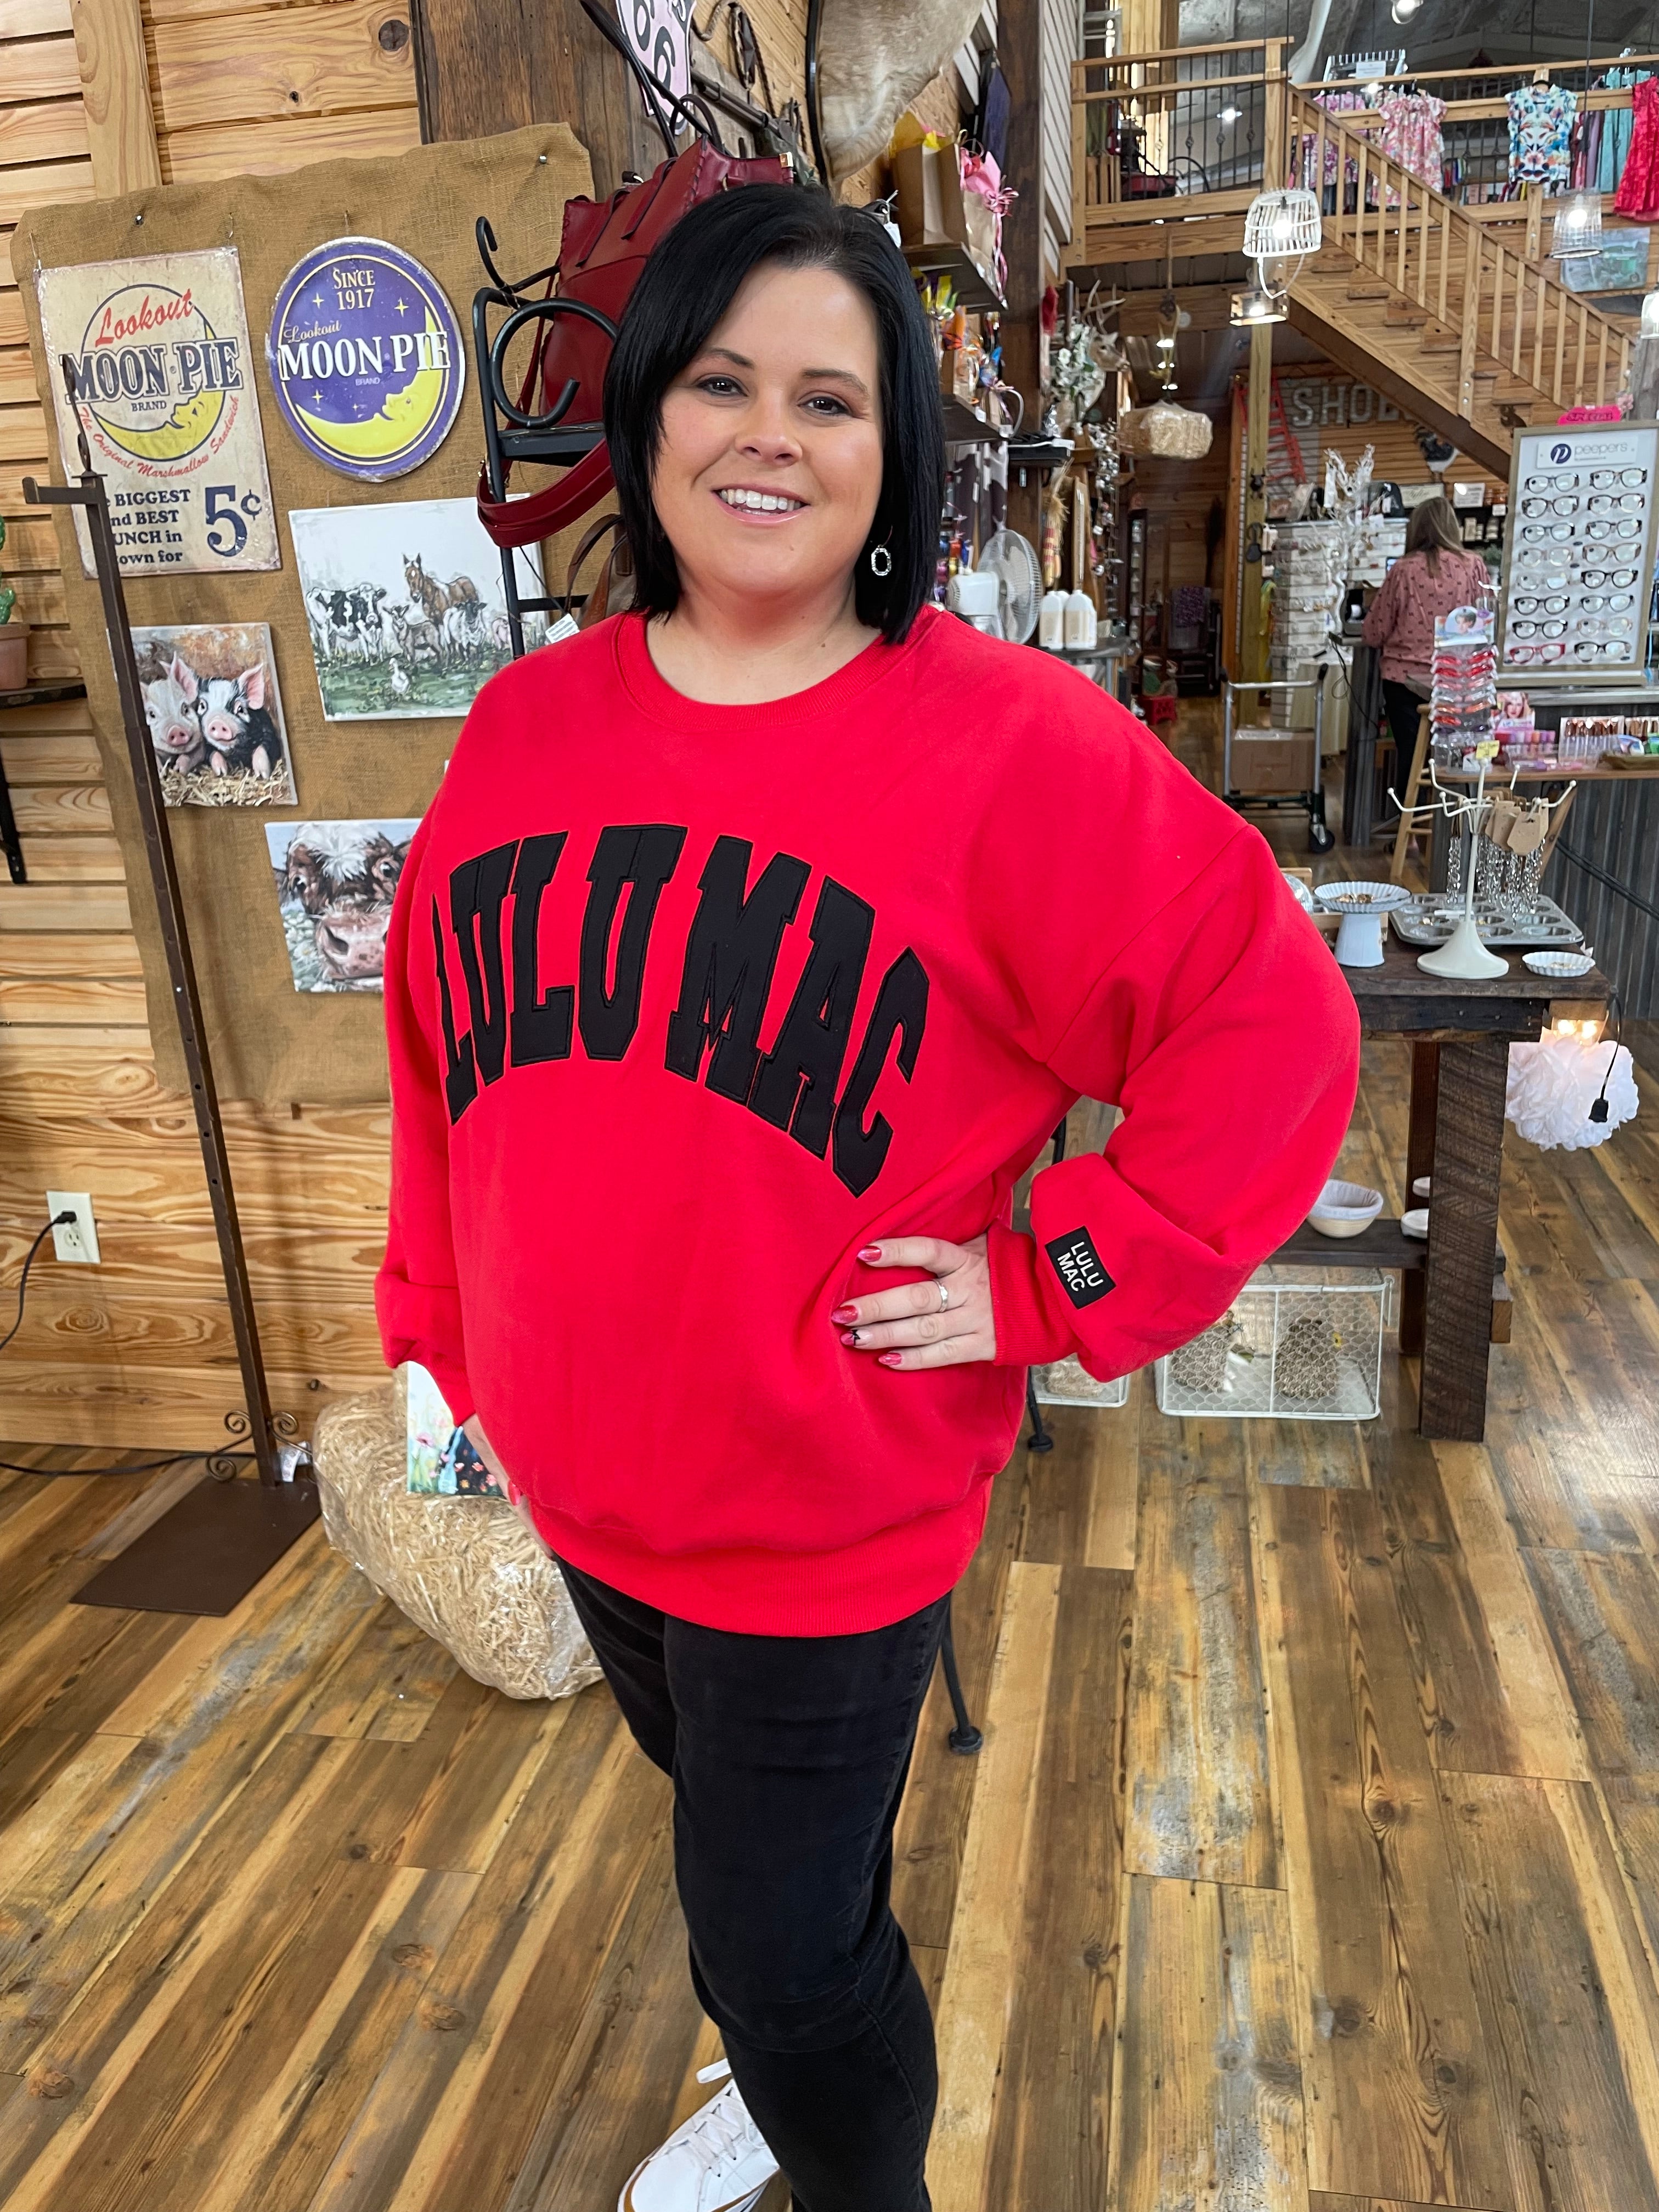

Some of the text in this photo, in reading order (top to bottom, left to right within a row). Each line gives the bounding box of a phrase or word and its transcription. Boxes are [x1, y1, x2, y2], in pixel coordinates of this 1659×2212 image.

[332, 268, 376, 289] SINCE
[336, 289, 375, 311] 1917
[95, 289, 195, 348] Lookout
[283, 320, 342, 344] Lookout
[278, 331, 451, 382] MOON PIE
[60, 337, 244, 403] MOON PIE
[355, 377, 381, 386] BRAND
[131, 400, 167, 412] BRAND
[78, 395, 239, 478] The Original Marshmallow Sandwich
[1574, 442, 1628, 456] peepers
[114, 489, 191, 506] BIGGEST
[110, 510, 179, 527] nd BEST
[113, 530, 183, 546] UNCH in
[117, 550, 183, 565] own for
[433, 824, 930, 1199] LULU MAC
[1057, 1252, 1085, 1292] MAC
[1070, 1242, 1104, 1287] LULU
